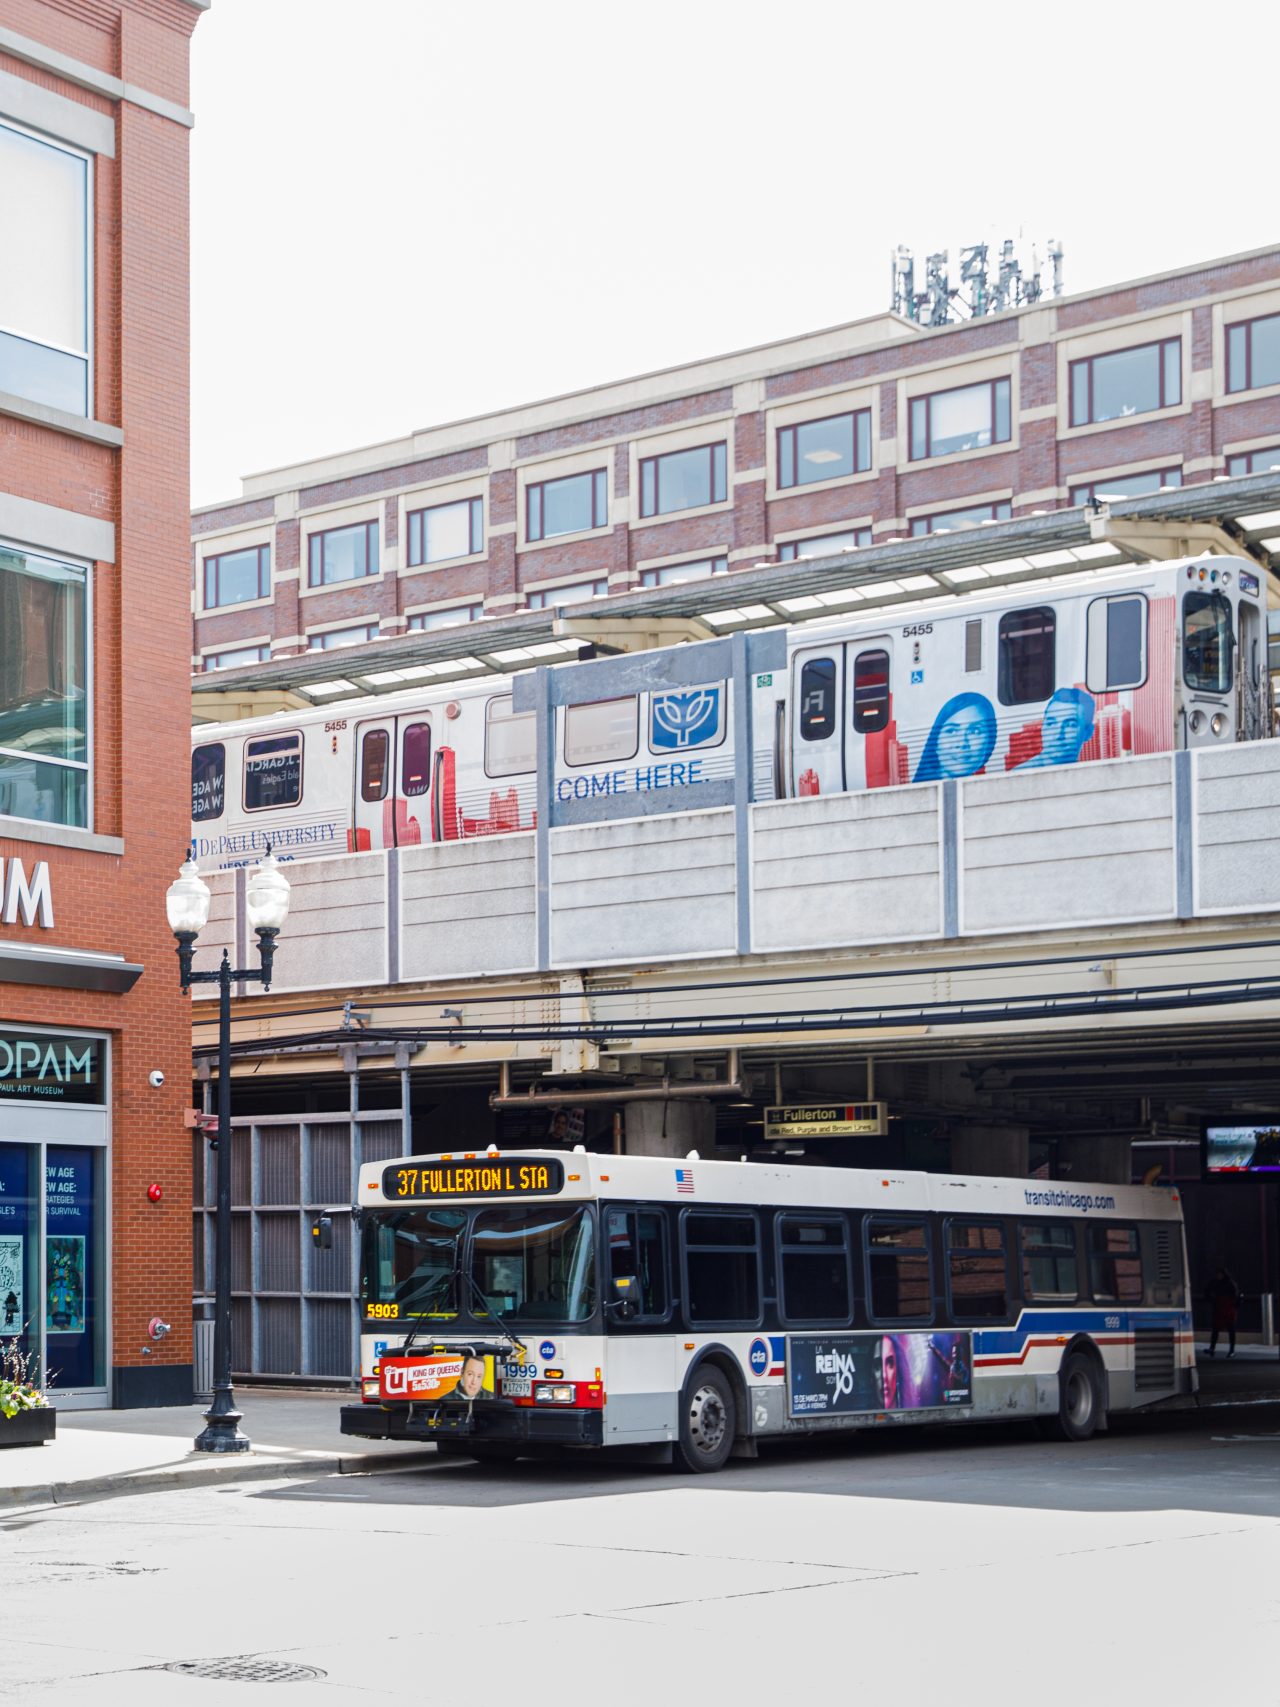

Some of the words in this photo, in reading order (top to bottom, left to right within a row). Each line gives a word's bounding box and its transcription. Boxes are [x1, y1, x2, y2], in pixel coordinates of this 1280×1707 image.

[903, 623, 933, 638] 5455
[324, 720, 347, 732] 5455
[558, 770, 627, 801] COME
[636, 760, 710, 791] HERE.
[33, 1086, 64, 1095] MUSEUM
[783, 1109, 837, 1121] Fullerton
[797, 1126, 817, 1135] Purple
[832, 1123, 852, 1132] Brown
[854, 1122, 871, 1131] Lines
[58, 1167, 74, 1178] AGE
[58, 1182, 77, 1193] AGE:
[398, 1170, 418, 1196] 37
[421, 1168, 501, 1193] FULLERTON
[505, 1167, 515, 1190] L
[520, 1166, 548, 1190] STA
[1024, 1189, 1115, 1212] transitchicago.com
[51, 1207, 81, 1216] SURVIVAL
[367, 1304, 399, 1318] 5903
[751, 1350, 766, 1363] cta
[815, 1346, 823, 1354] LA
[412, 1369, 427, 1378] KING
[428, 1367, 436, 1375] OF
[437, 1364, 460, 1376] QUEENS
[503, 1363, 537, 1378] 1999
